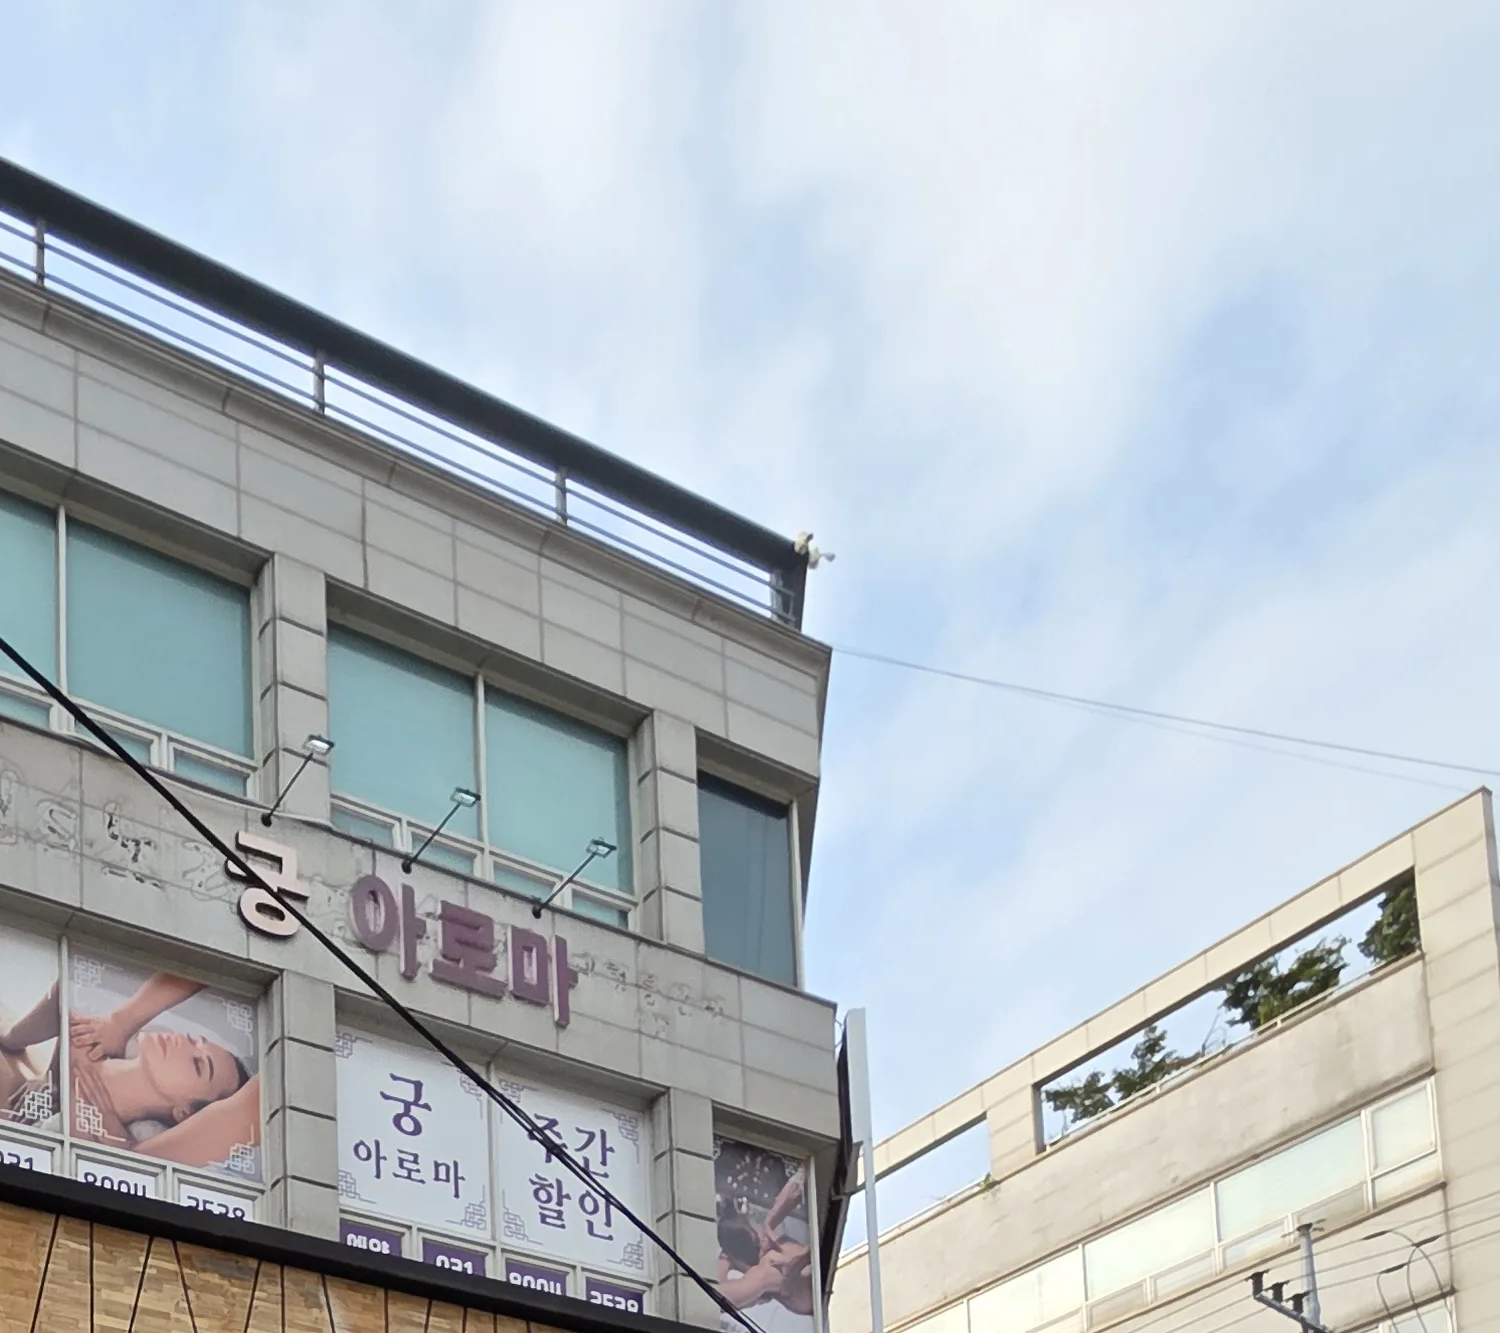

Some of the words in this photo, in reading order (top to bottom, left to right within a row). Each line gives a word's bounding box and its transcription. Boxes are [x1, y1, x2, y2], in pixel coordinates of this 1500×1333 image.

[225, 828, 311, 938] 궁
[349, 873, 581, 1030] 아로마
[379, 1072, 432, 1138] 궁
[352, 1138, 467, 1200] 아로마
[527, 1111, 616, 1182] 주간
[527, 1171, 615, 1243] 할인
